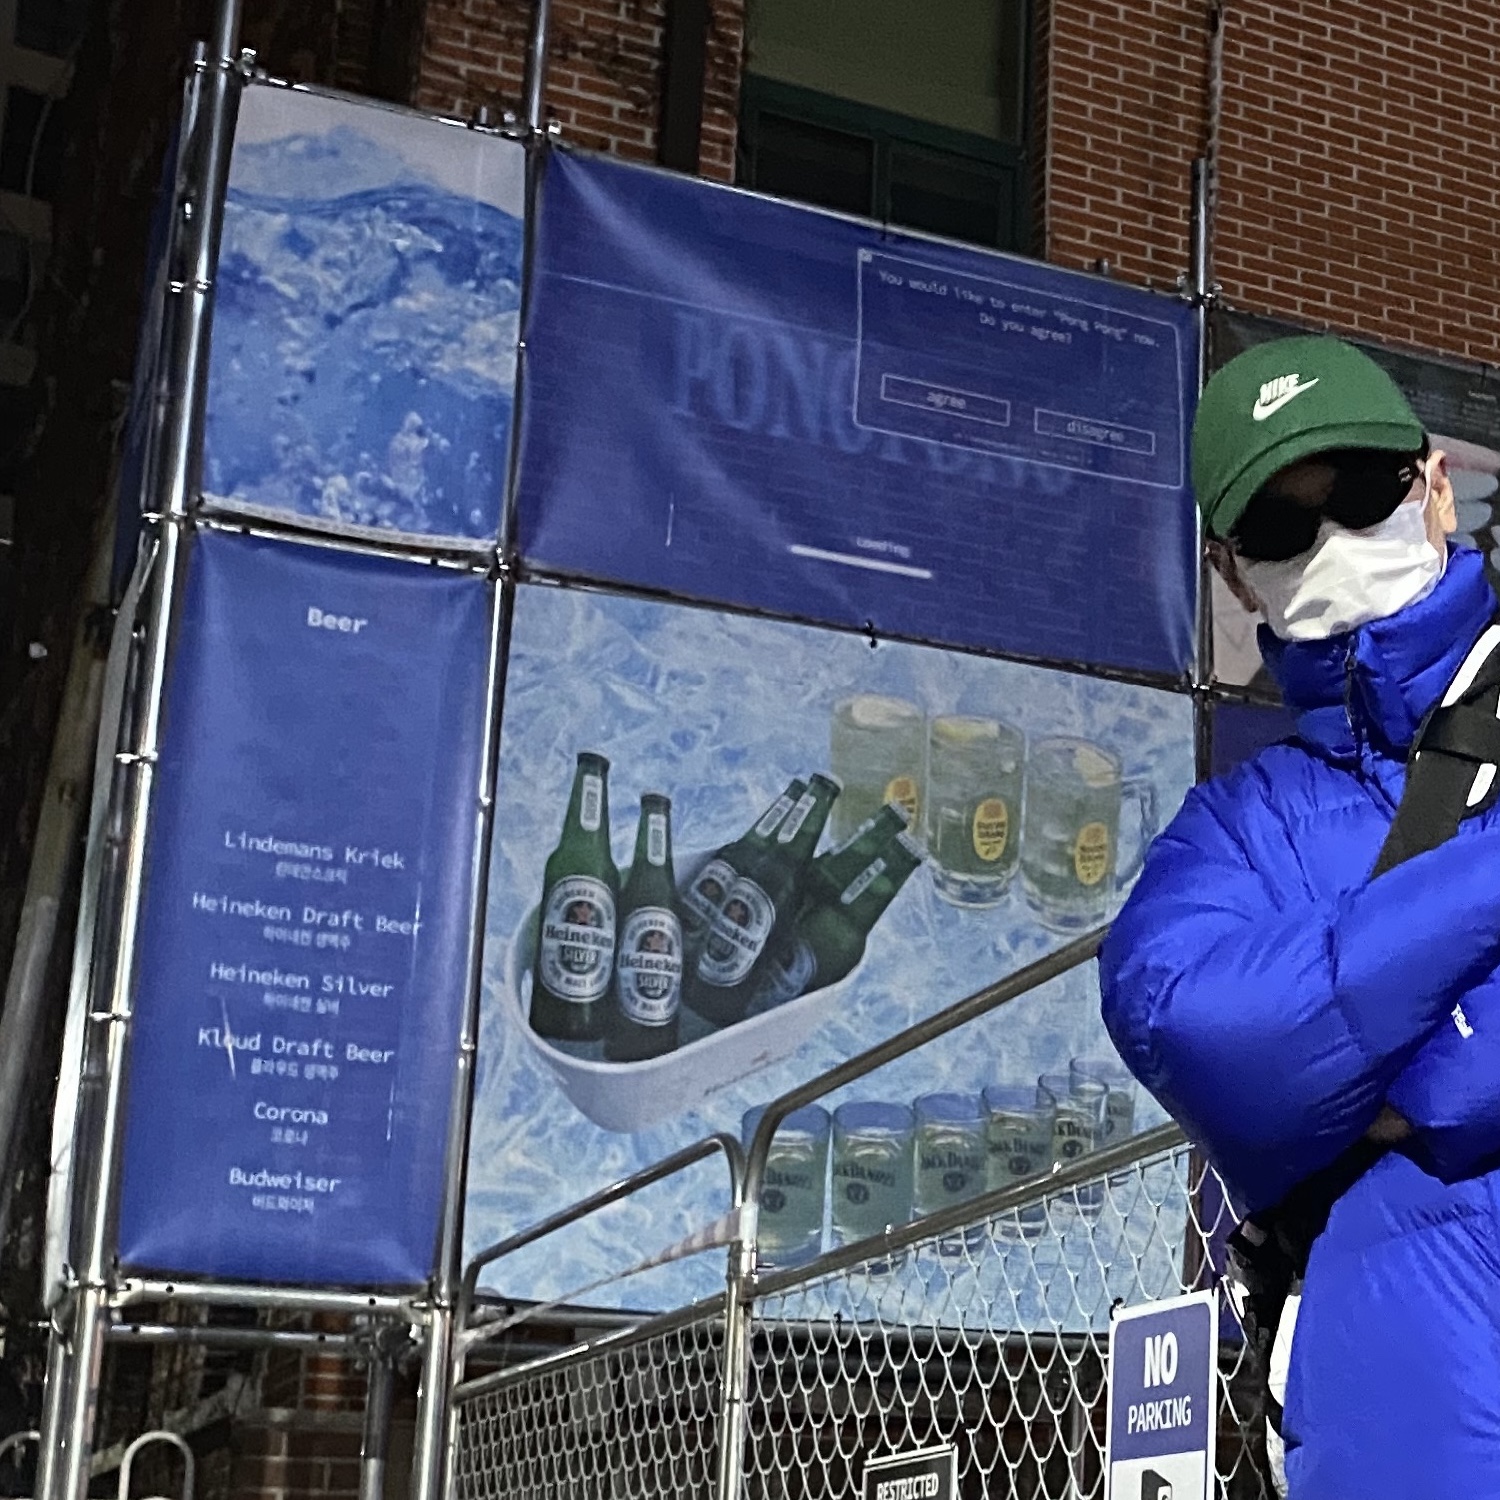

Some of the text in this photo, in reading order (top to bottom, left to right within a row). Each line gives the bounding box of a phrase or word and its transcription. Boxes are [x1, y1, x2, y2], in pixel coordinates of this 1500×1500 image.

[879, 270, 903, 286] You
[909, 279, 948, 296] would
[954, 287, 983, 305] like
[990, 297, 1006, 309] to
[1011, 302, 1047, 318] enter
[979, 312, 996, 326] Do
[1002, 318, 1025, 333] you
[1260, 373, 1300, 407] NIKE
[308, 607, 368, 634] Beer
[225, 830, 405, 870] Lindemans Kriek
[193, 892, 423, 935] Heineken Draft Beer
[210, 962, 394, 997] Heineken Silver
[198, 1028, 395, 1063] Kloud Draft Beer
[254, 1101, 329, 1125] Corona
[229, 1167, 342, 1193] Budweiser
[1143, 1331, 1179, 1389] NO
[1127, 1396, 1191, 1434] PARKING
